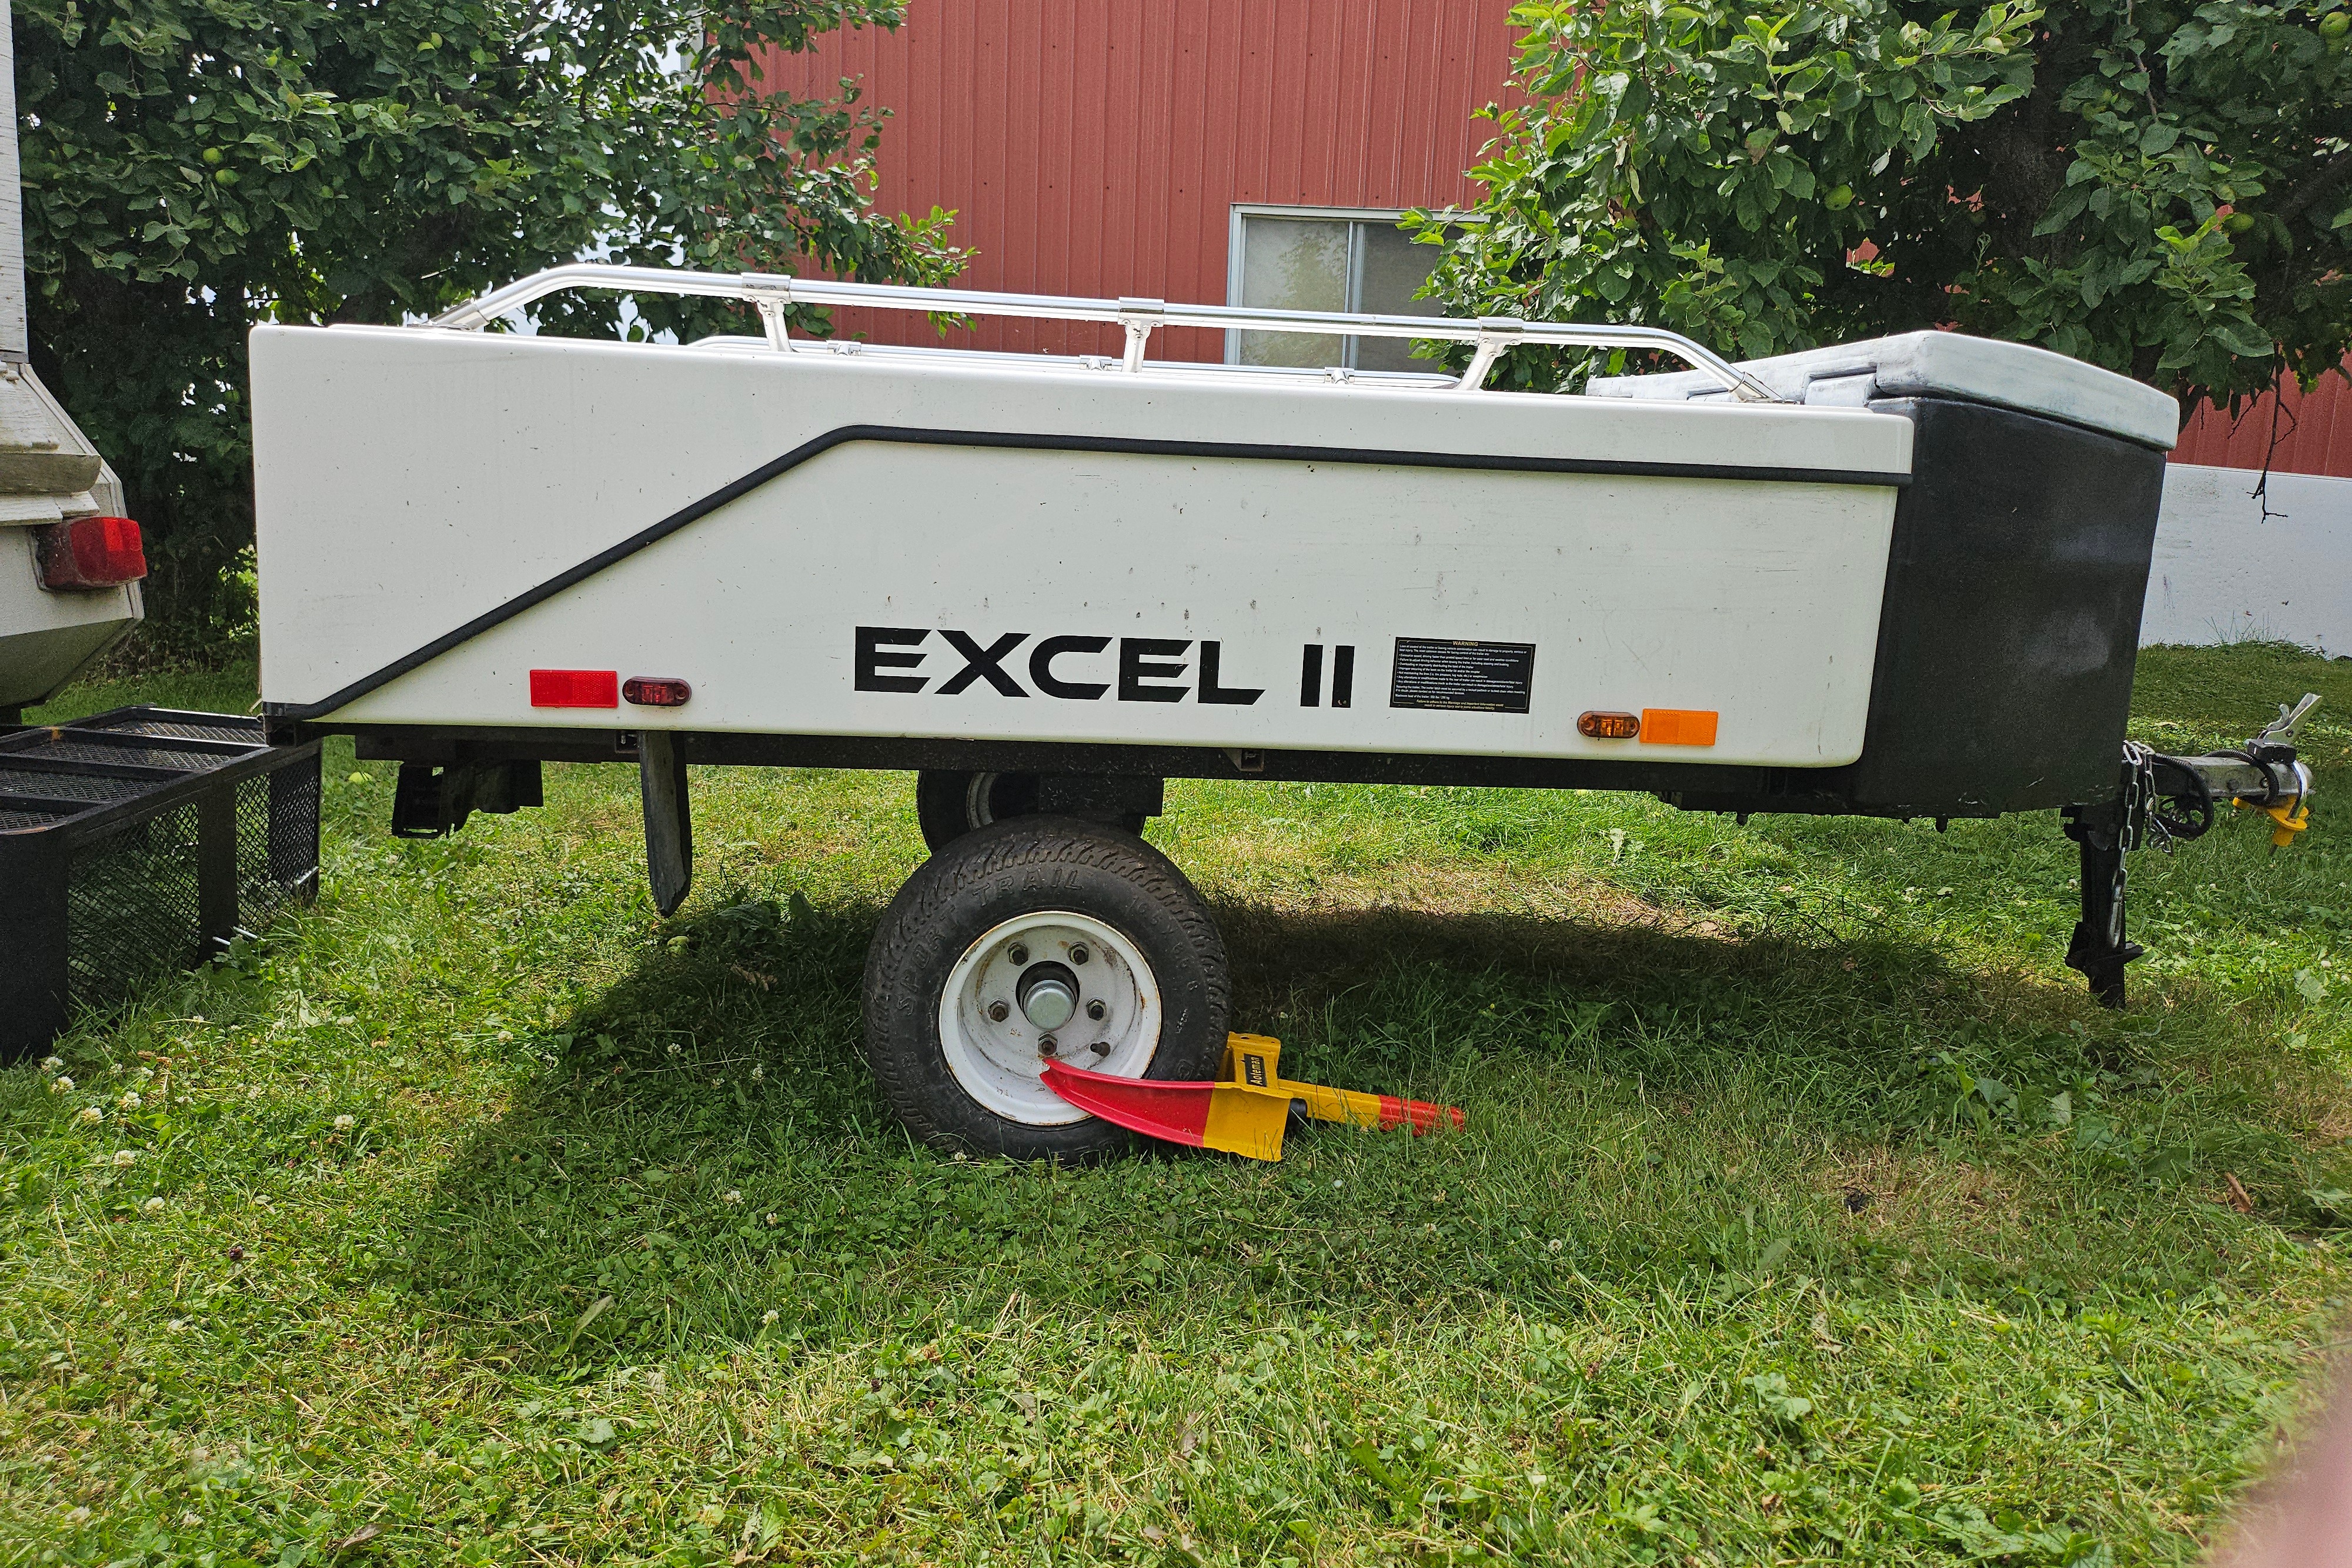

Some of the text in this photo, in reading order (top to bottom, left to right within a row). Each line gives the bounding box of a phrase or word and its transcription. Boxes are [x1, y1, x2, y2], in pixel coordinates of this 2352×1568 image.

[854, 626, 1355, 708] EXCEL II
[896, 868, 1083, 1016] SPORT TRAIL
[1250, 1057, 1263, 1085] Aoteman
